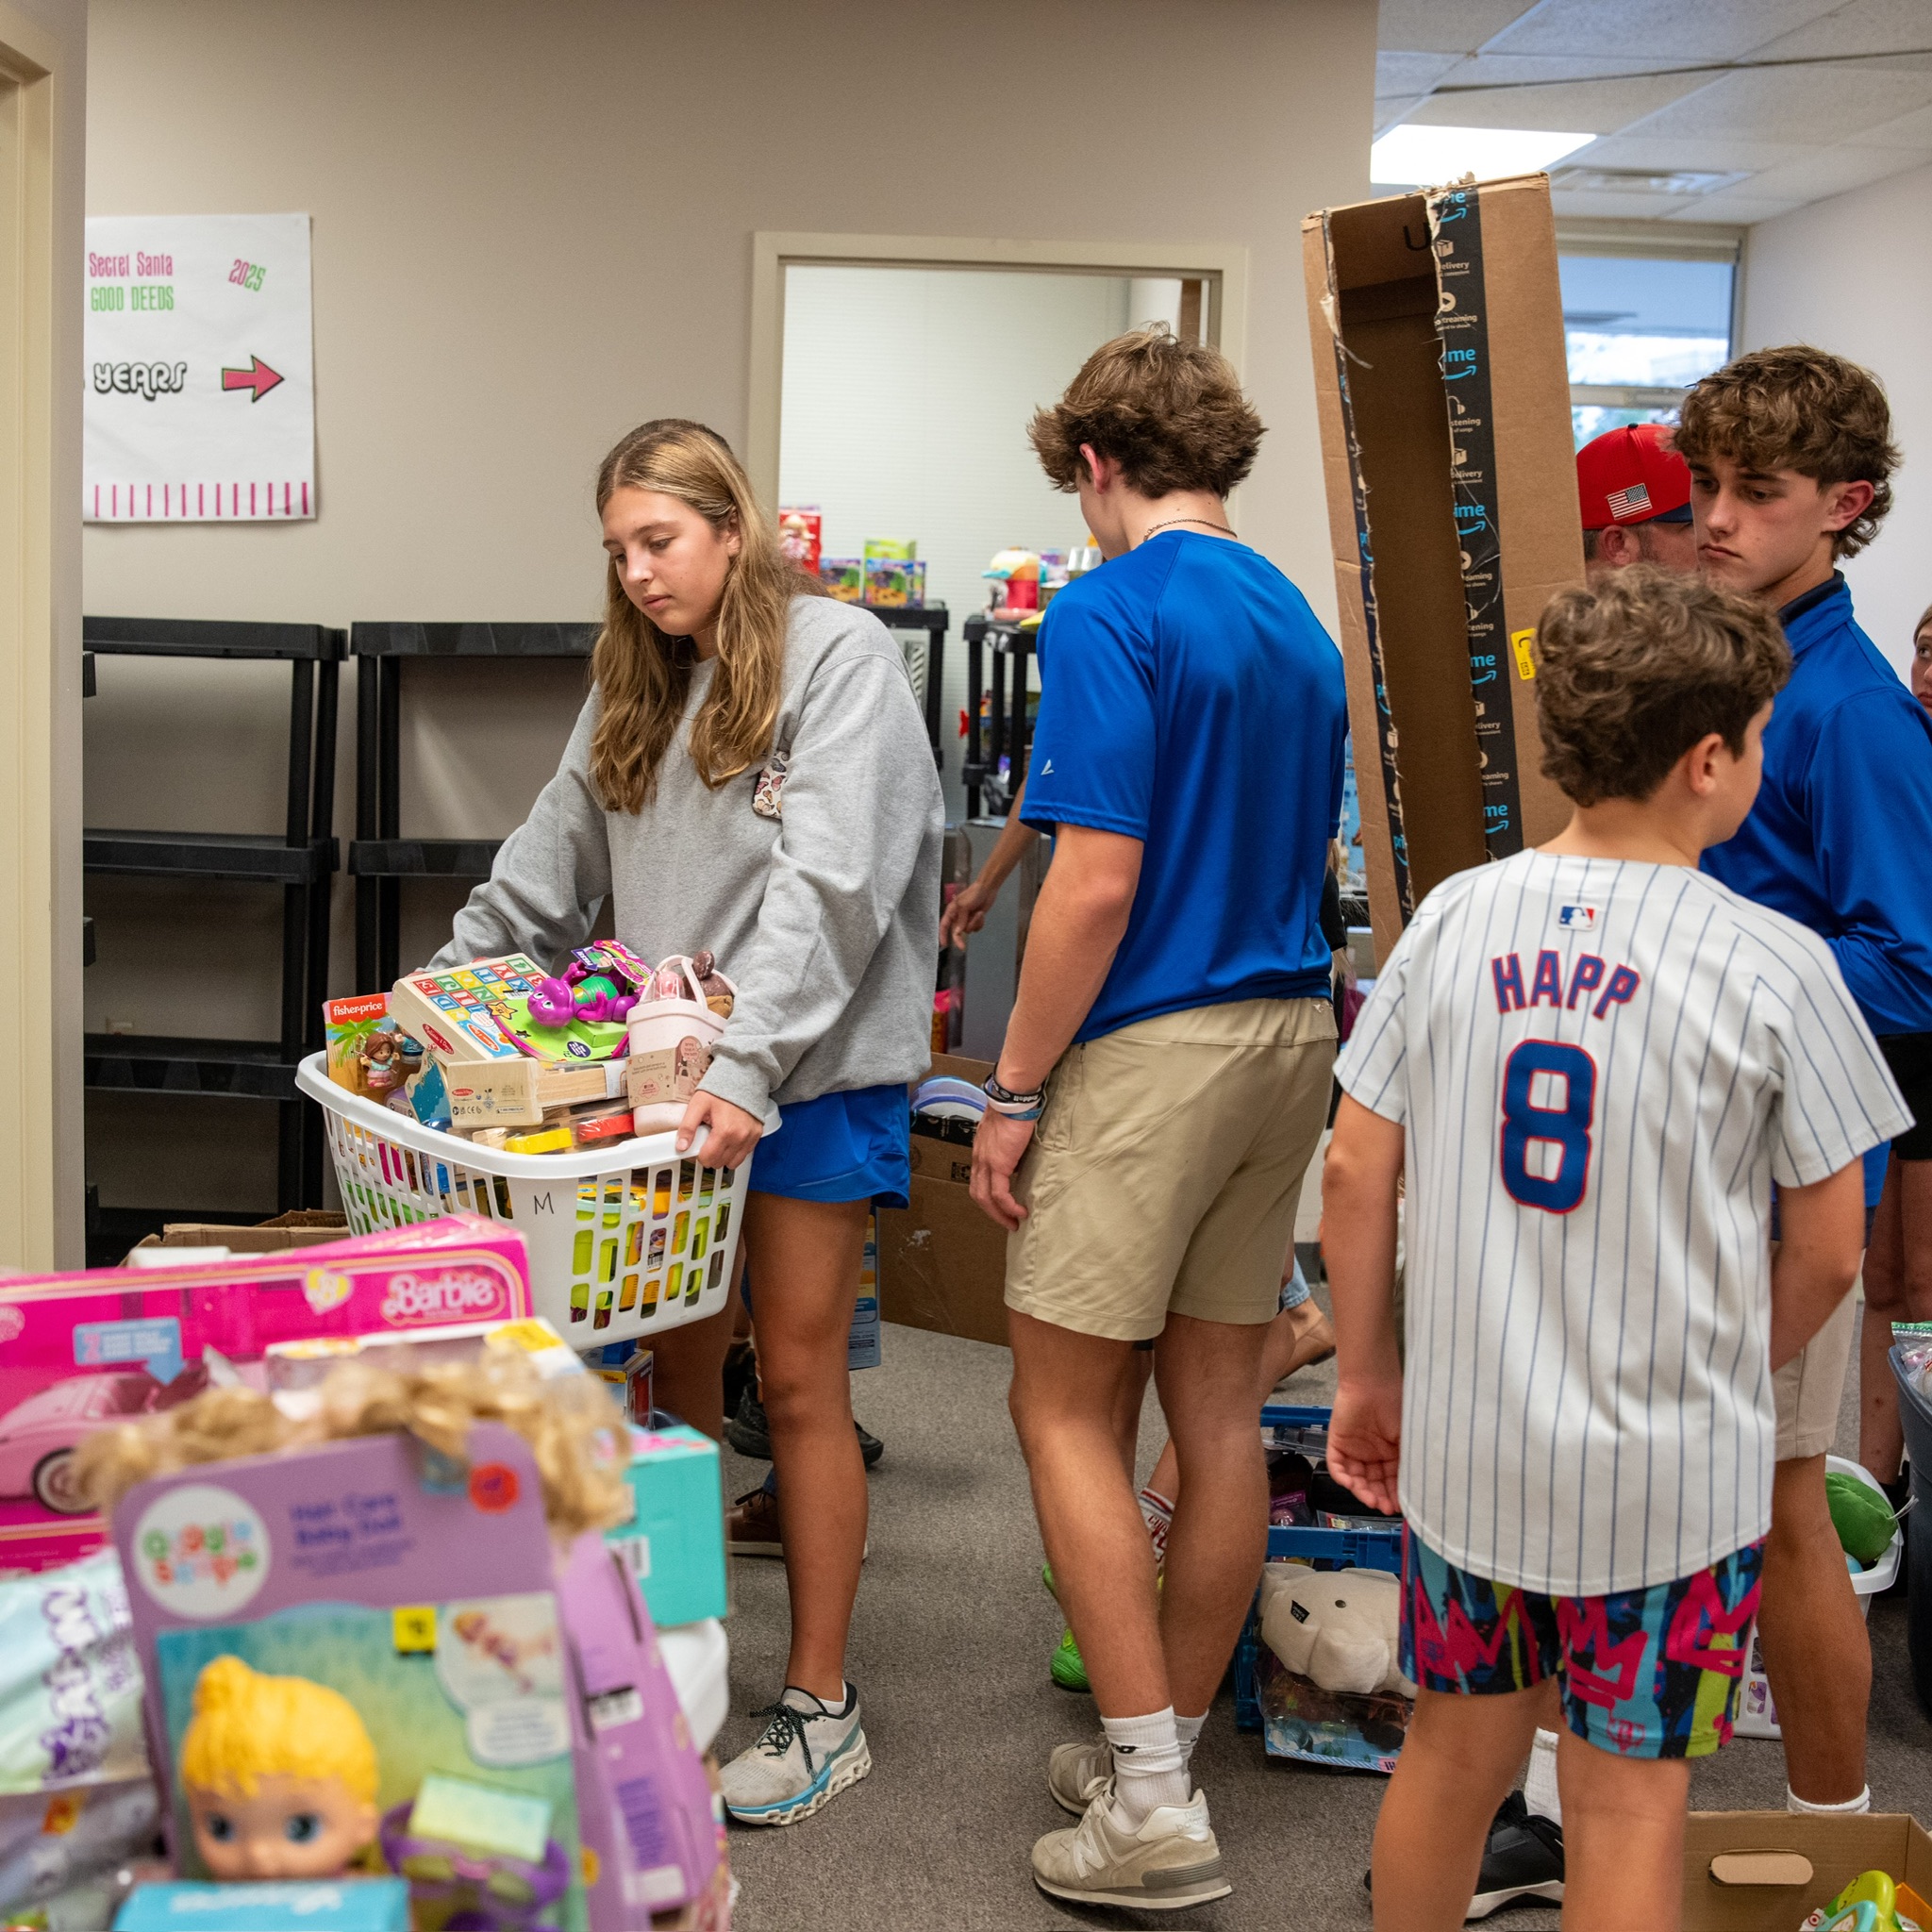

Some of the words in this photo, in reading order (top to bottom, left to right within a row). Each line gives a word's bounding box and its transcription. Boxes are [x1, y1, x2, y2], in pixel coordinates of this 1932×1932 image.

[89, 252, 129, 277] Secret
[137, 251, 173, 276] Santa
[228, 258, 266, 291] 2025
[91, 286, 124, 311] GOOD
[131, 286, 175, 311] DEEDS
[93, 361, 188, 402] YEARS
[1491, 949, 1641, 1021] HAPP
[333, 1002, 383, 1016] fisher-price
[1500, 1038, 1598, 1215] 8
[533, 1191, 555, 1215] M
[383, 1273, 494, 1317] Barbie
[1175, 1814, 1208, 1832] balan
